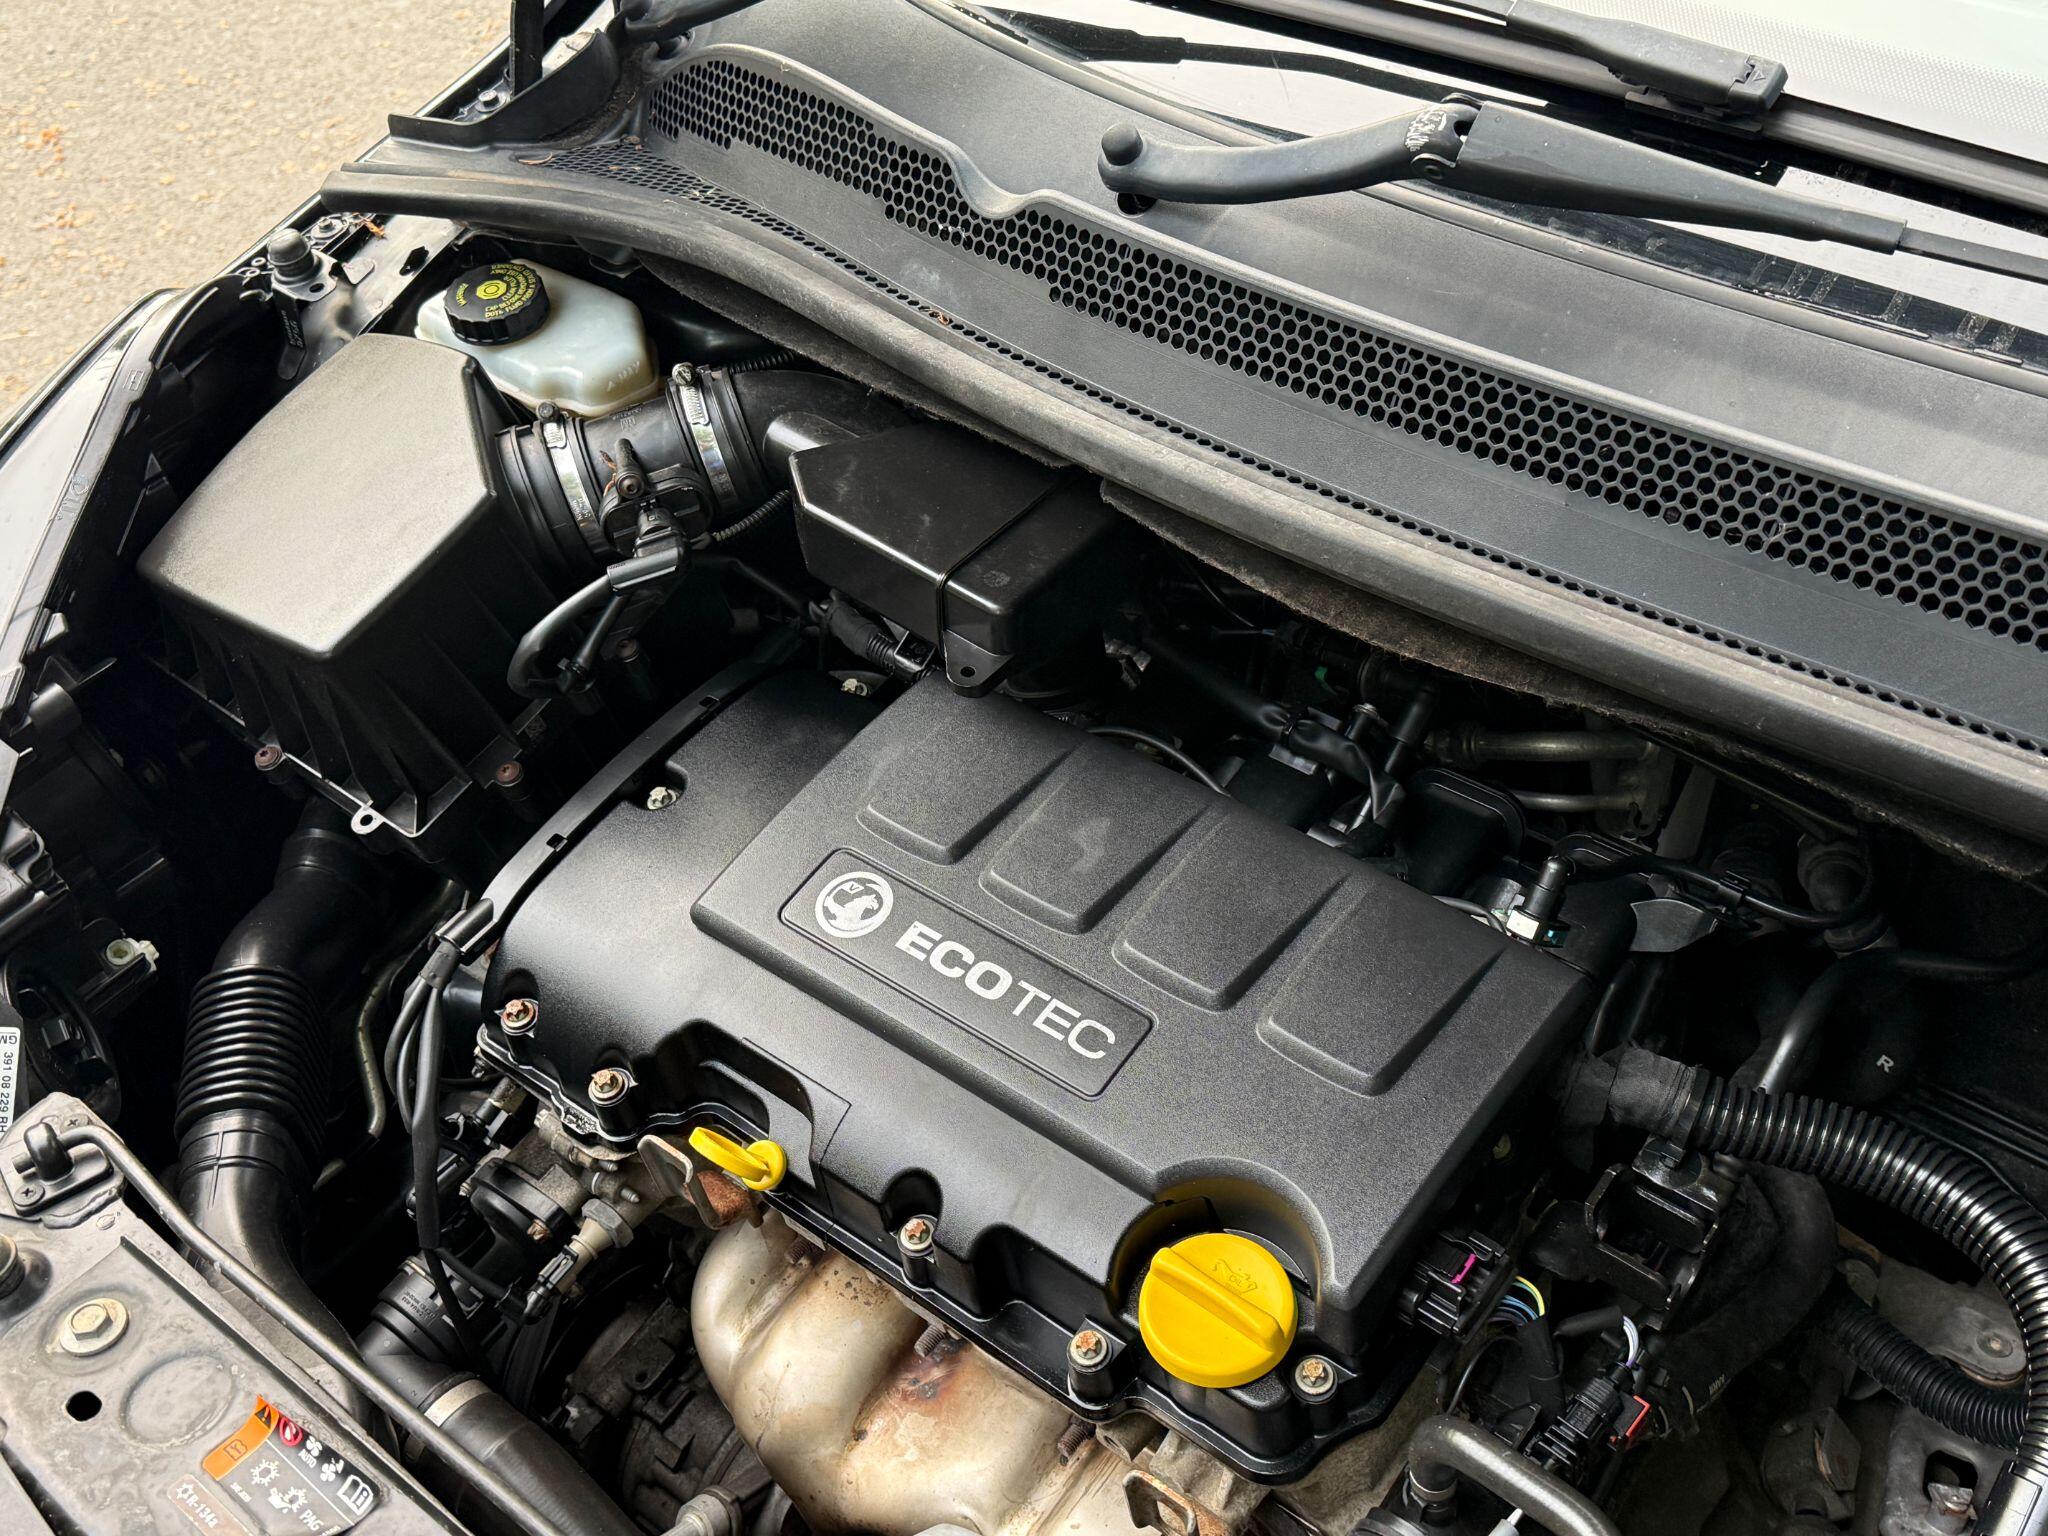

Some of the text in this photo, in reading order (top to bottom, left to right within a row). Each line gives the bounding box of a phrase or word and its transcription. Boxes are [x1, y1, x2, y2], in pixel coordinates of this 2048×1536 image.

[894, 921, 1116, 1059] ECOTEC
[3, 1051, 13, 1071] 391
[1876, 1054, 1895, 1073] R
[2, 1076, 11, 1089] 08
[0, 1092, 9, 1113] 229
[298, 1451, 317, 1468] AUTO
[186, 1493, 220, 1528] R-134a
[299, 1509, 324, 1532] PAG
